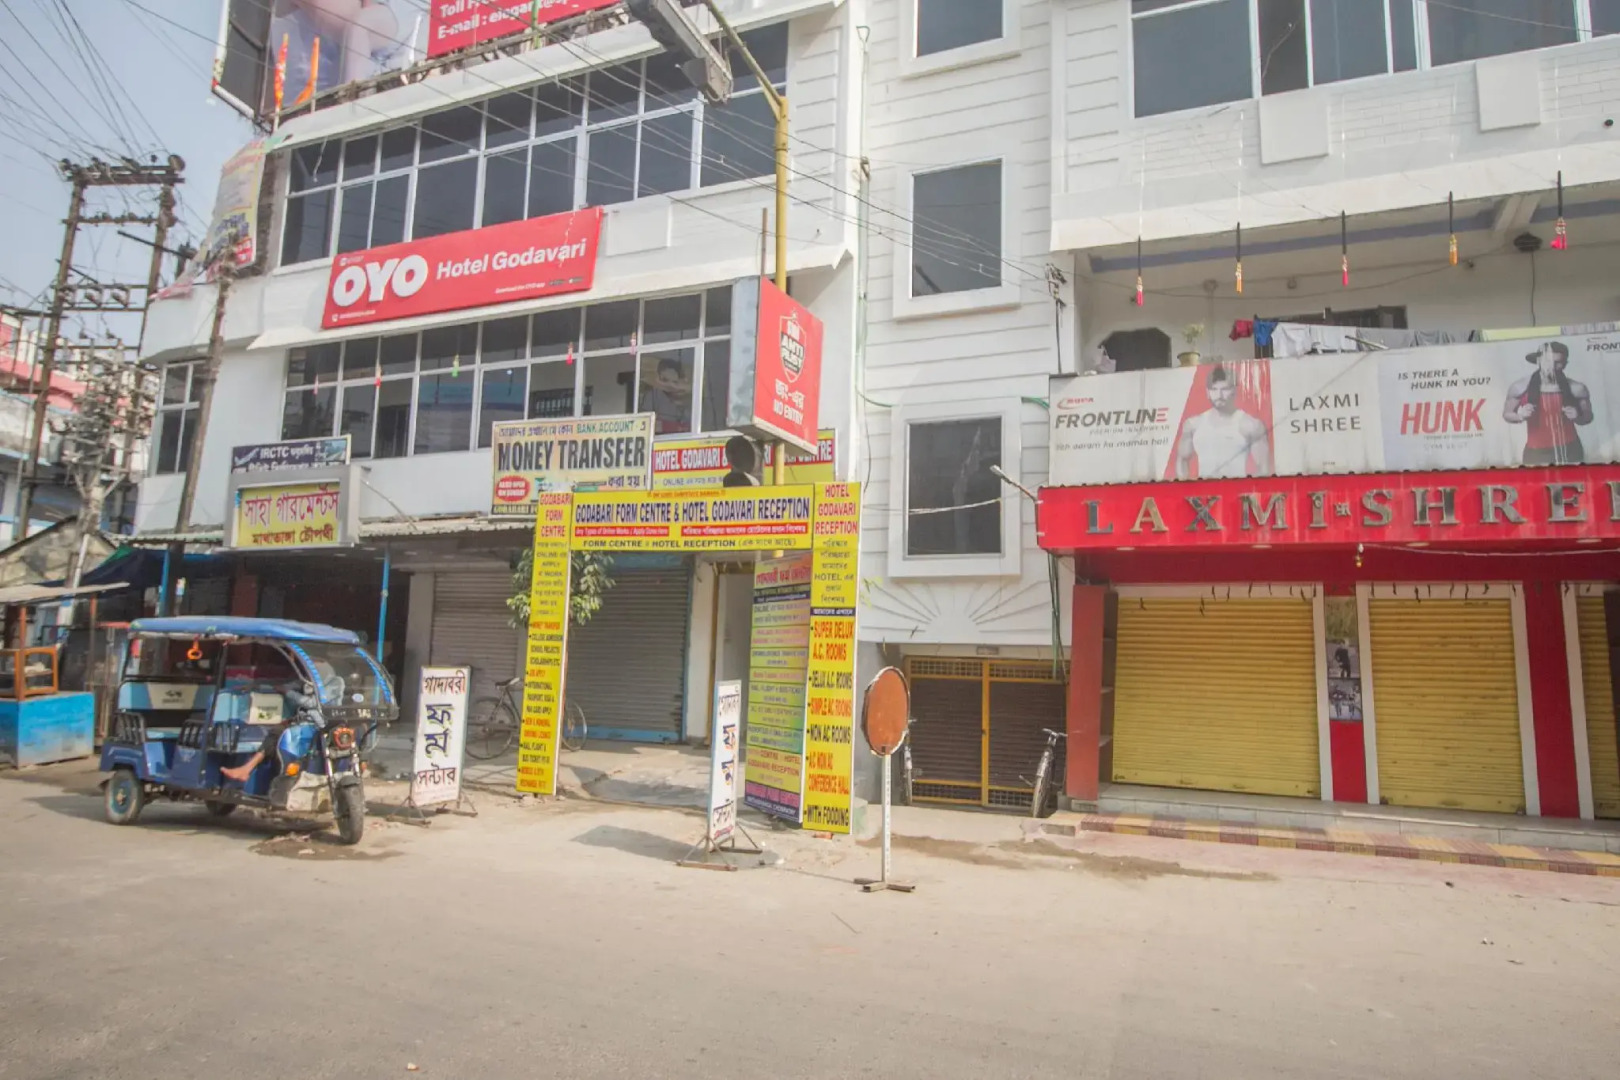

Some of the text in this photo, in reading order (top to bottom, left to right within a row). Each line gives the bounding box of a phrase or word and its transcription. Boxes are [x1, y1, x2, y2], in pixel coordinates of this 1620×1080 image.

[440, 0, 465, 17] Toll
[438, 14, 480, 39] E-mail
[436, 238, 586, 280] Hotel Godavari
[332, 254, 428, 307] OYO
[1412, 369, 1447, 379] THERE
[1451, 368, 1459, 377] A
[1410, 377, 1491, 391] HUNK IN YOU?
[1289, 393, 1360, 411] LAXMI
[1055, 407, 1170, 429] FRONTLINE
[1290, 416, 1361, 434] SHREE
[1400, 398, 1487, 436] HUNK
[577, 422, 596, 433] BANK
[598, 421, 634, 432] ACCOUNT
[260, 447, 290, 459] IRCTC
[498, 436, 645, 471] MONEY TRANSFER
[655, 450, 680, 470] HOTEL
[681, 446, 721, 468] GODAVARI
[825, 484, 850, 498] HOTEL
[545, 509, 563, 521] FORM
[575, 497, 810, 522] GODABARI FORM CENTRE & HOTEL GODAVARI RECEPTION
[818, 502, 856, 516] GODAVARI
[1084, 491, 1328, 534] LAXMI
[541, 526, 566, 537] CENTRE
[815, 521, 858, 534] RECEPTION
[583, 540, 606, 548] FORM
[609, 539, 642, 548] CENTRE
[652, 539, 681, 548] HOTEL
[683, 539, 736, 548] RECEPTION
[813, 620, 833, 640] SUPER
[826, 643, 847, 661] ROOMS
[810, 723, 822, 742] NON
[831, 726, 851, 745] ROOMS
[807, 804, 822, 823] WITH
[823, 806, 849, 826] FOODING
